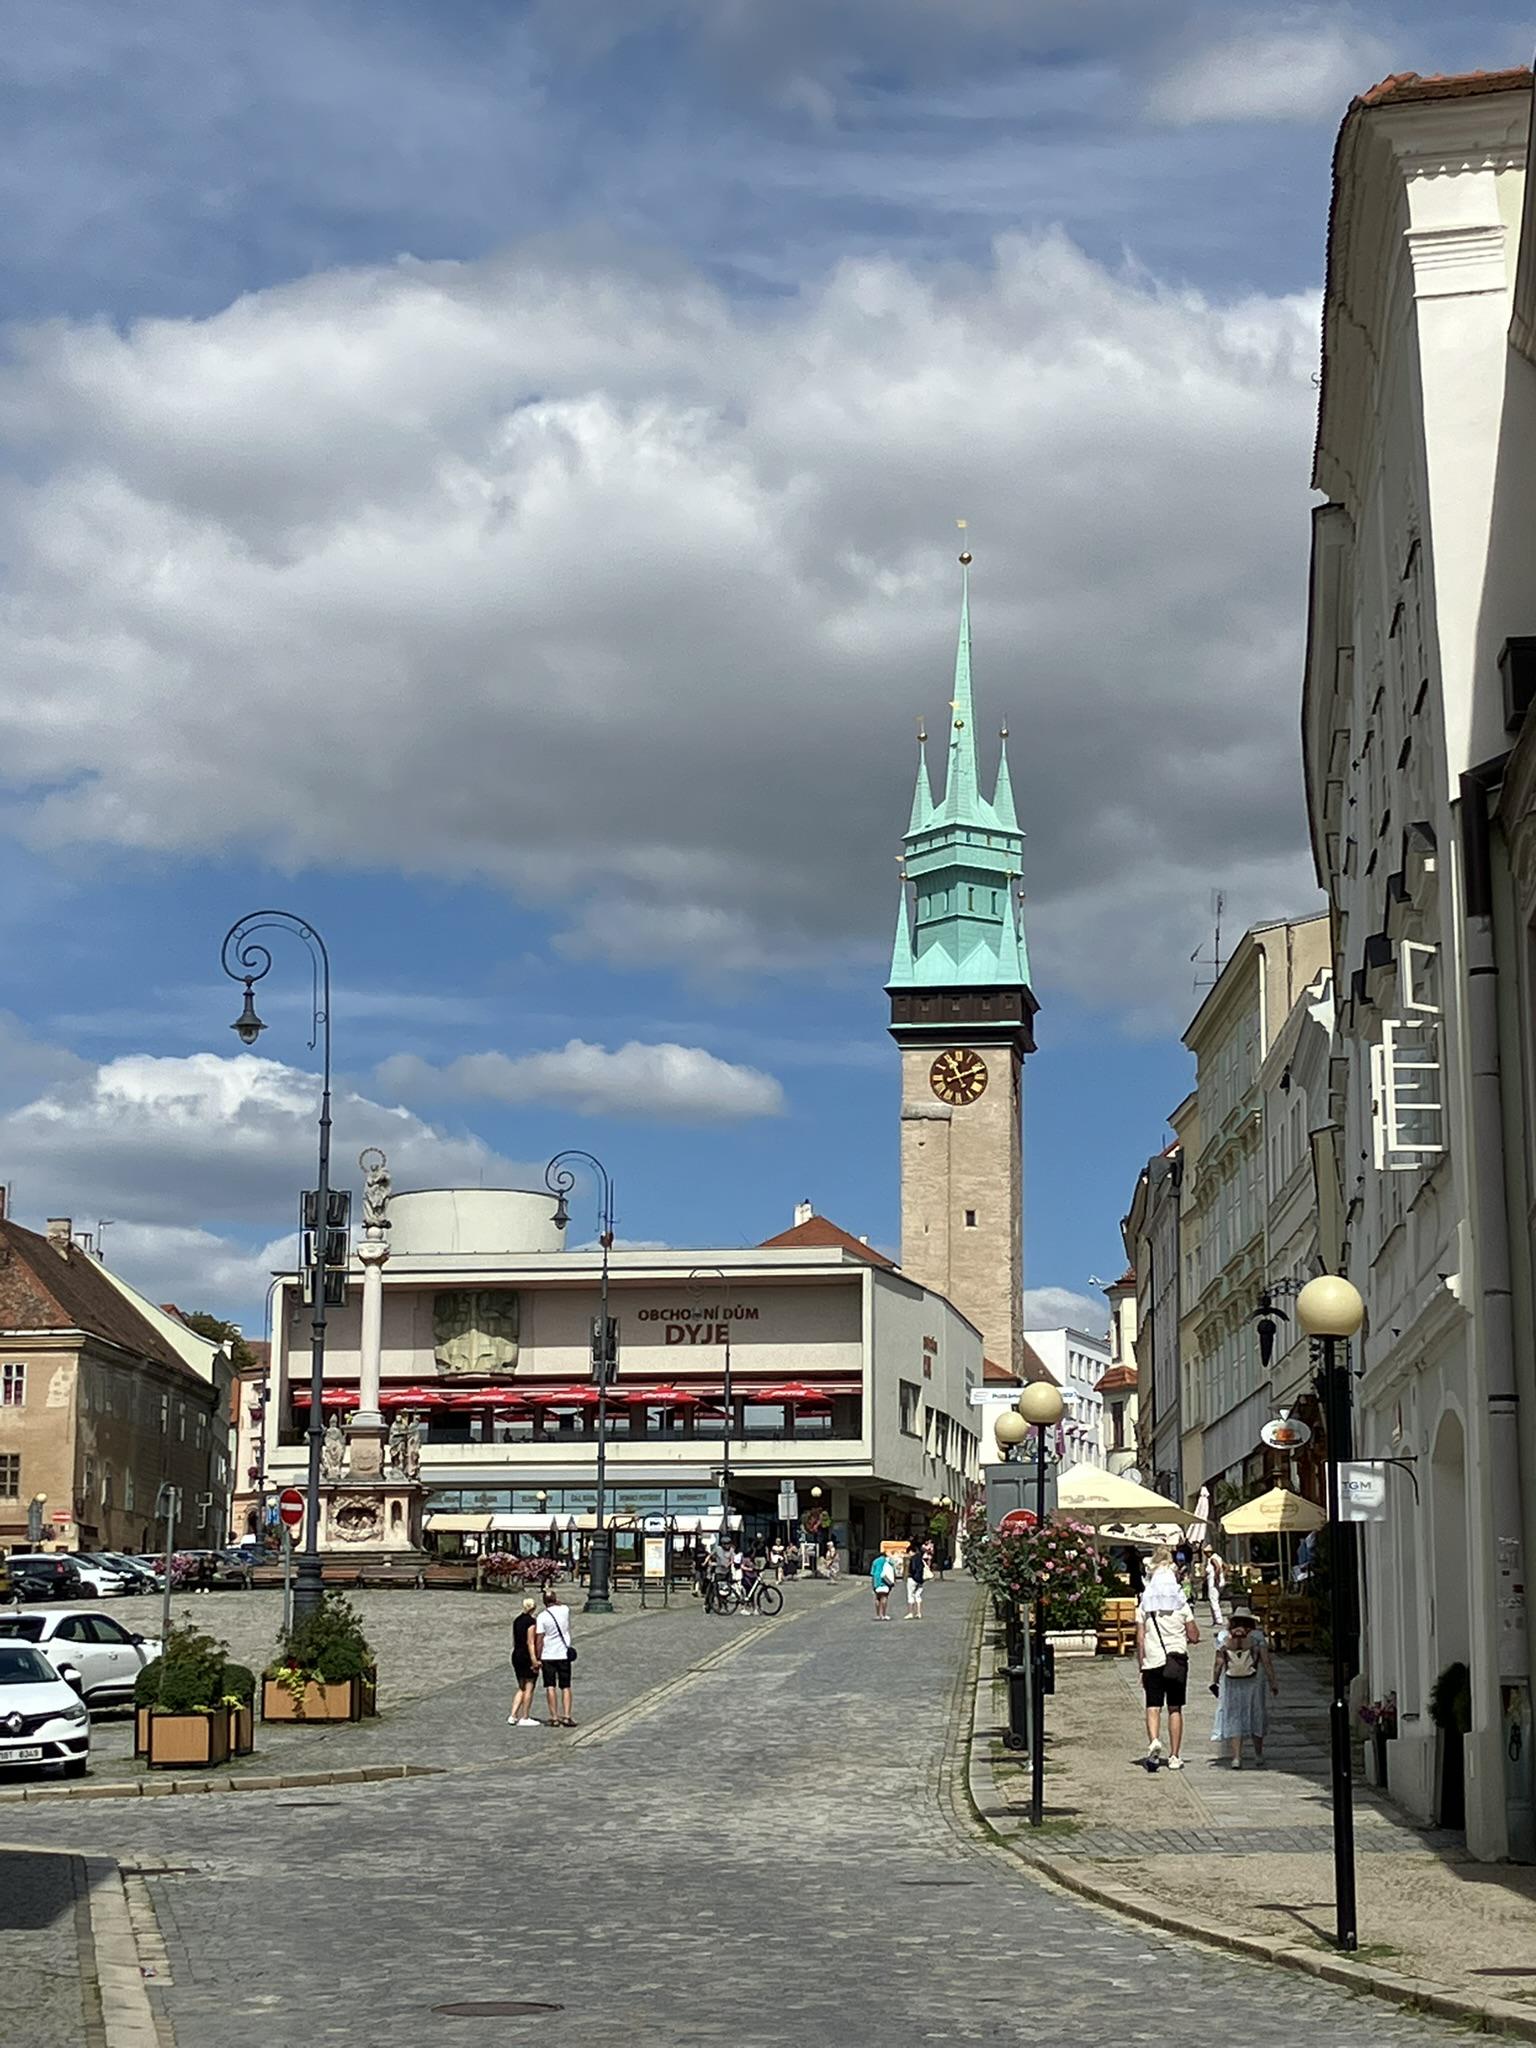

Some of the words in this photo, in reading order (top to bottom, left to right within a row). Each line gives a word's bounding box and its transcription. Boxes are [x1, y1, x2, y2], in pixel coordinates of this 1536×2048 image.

[638, 1305, 719, 1321] OBCHONÍ
[723, 1304, 759, 1320] DŮM
[665, 1323, 729, 1344] DYJE
[1341, 1480, 1372, 1490] TGM
